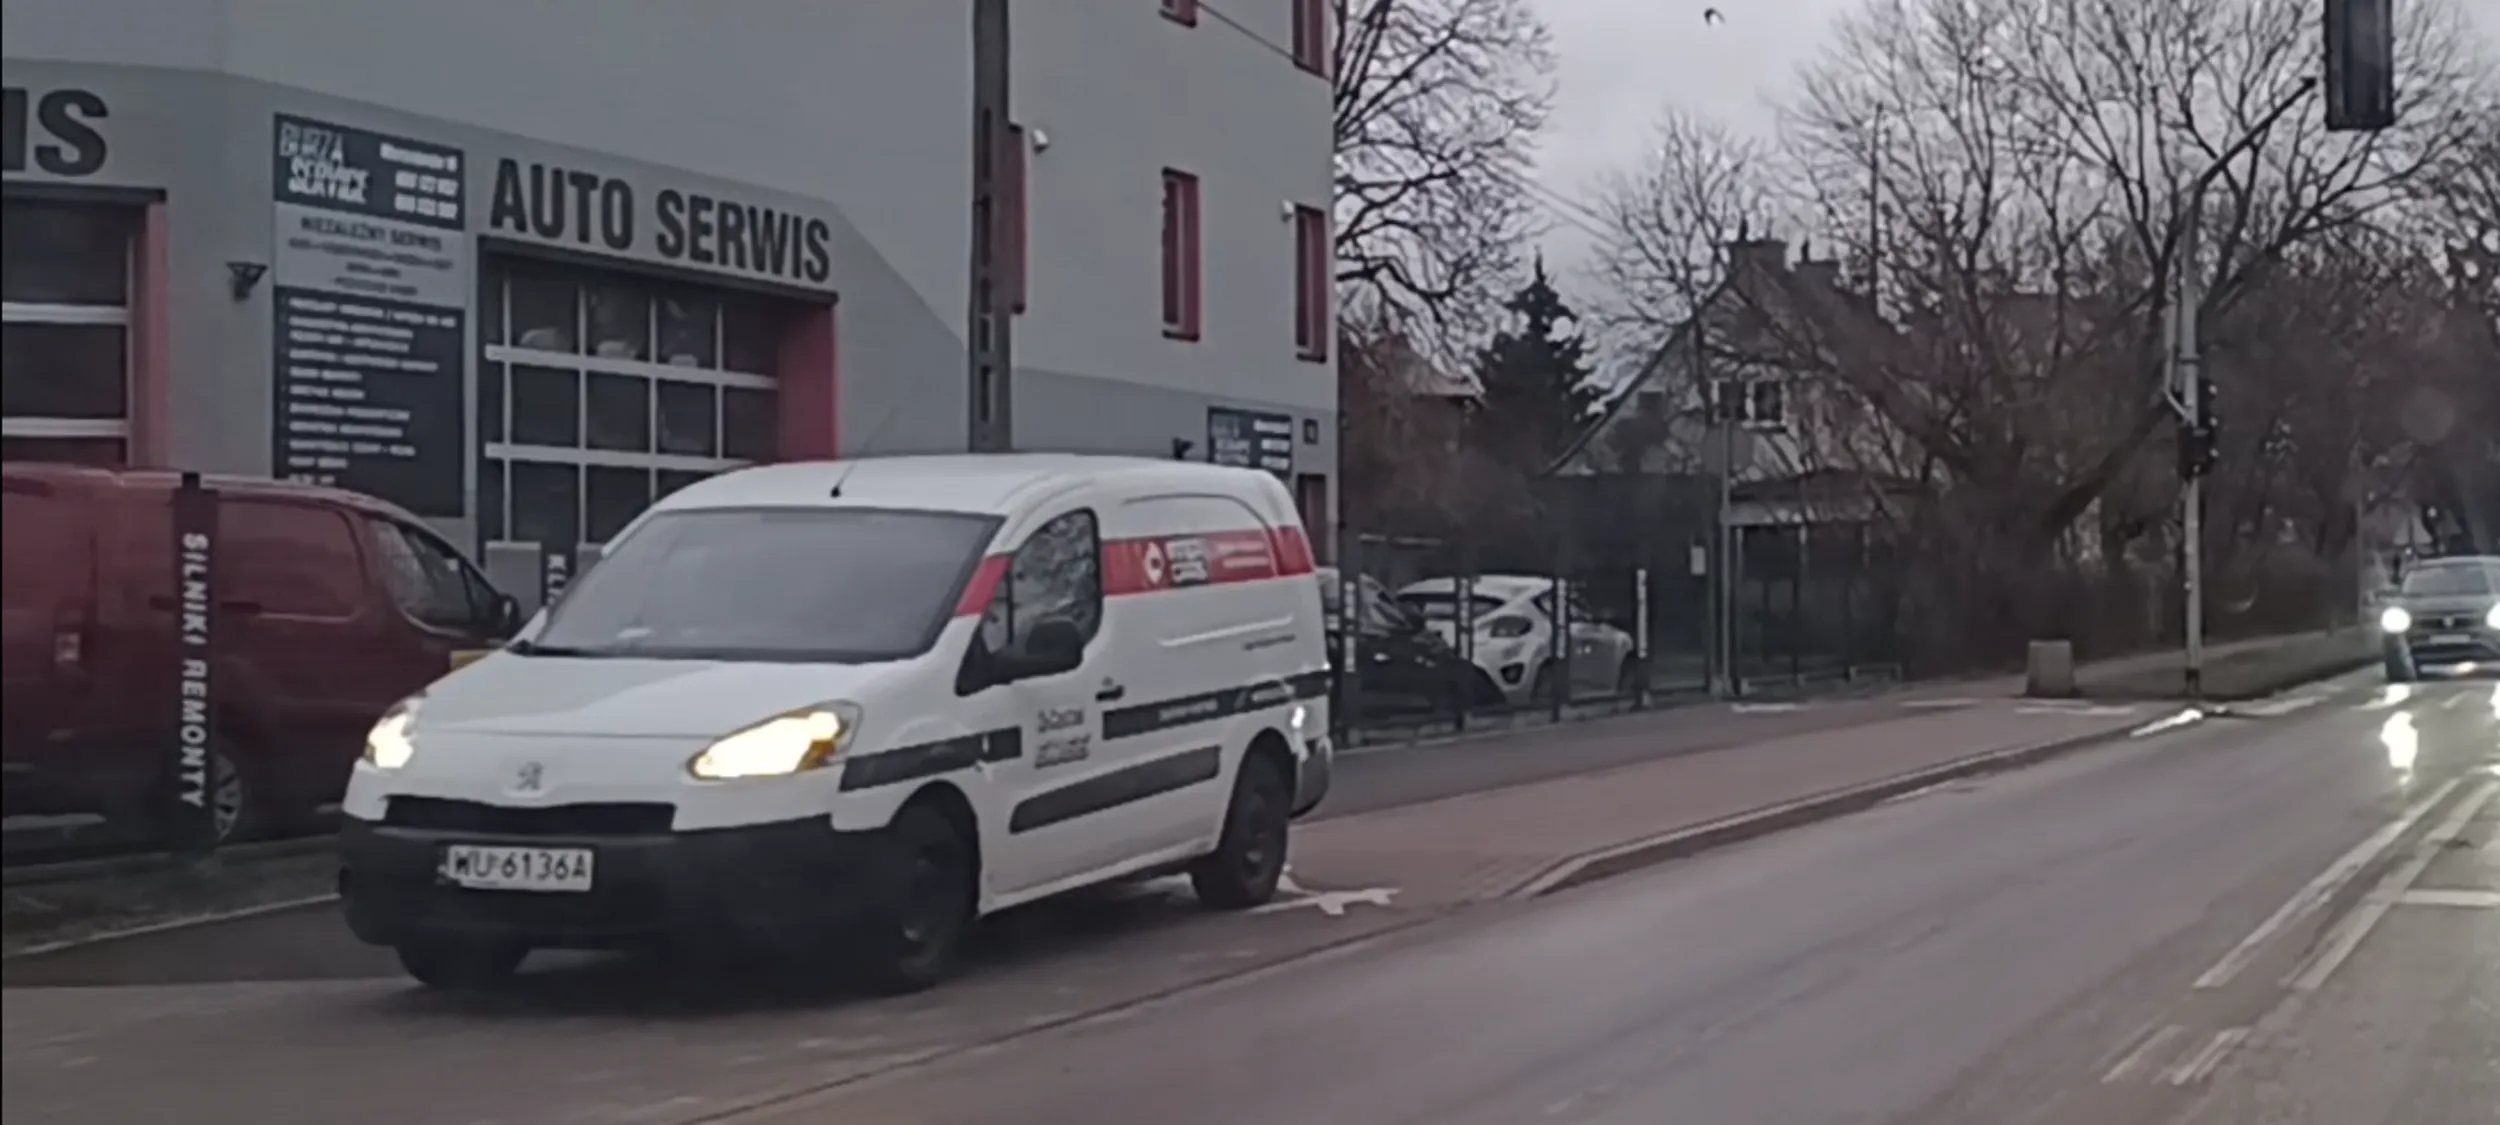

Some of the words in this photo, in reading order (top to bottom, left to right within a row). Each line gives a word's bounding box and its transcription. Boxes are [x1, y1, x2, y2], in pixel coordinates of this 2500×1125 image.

[489, 157, 634, 251] AUTO
[655, 189, 831, 283] SERWIS
[182, 533, 208, 645] SILNIKI
[181, 659, 207, 807] REMONTY
[502, 851, 587, 880] 6136A
